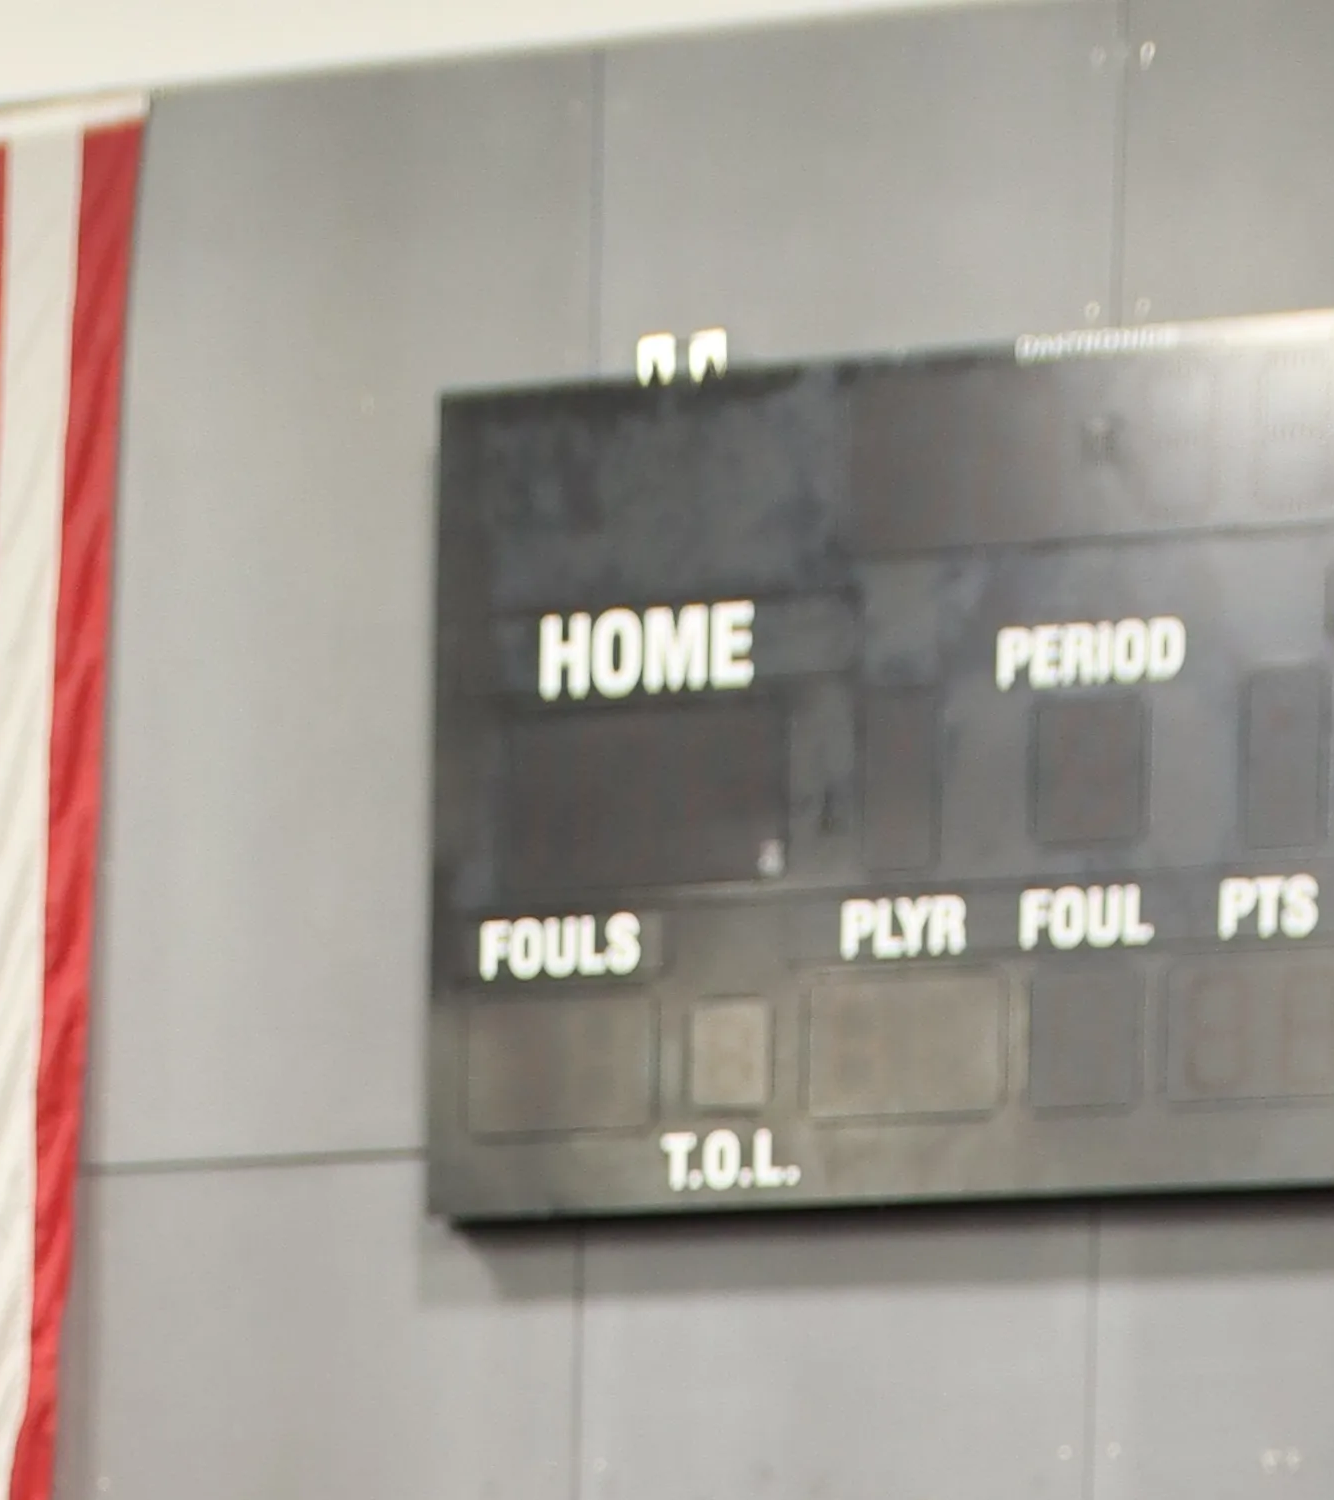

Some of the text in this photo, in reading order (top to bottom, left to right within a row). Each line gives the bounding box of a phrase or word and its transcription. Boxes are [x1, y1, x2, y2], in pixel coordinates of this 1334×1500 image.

[540, 601, 754, 697] HOME
[996, 616, 1186, 689] PERIOD
[841, 895, 966, 959] PLYR
[1020, 884, 1154, 949] FOUL
[1218, 874, 1318, 939] PTS
[480, 913, 640, 979] FOULS
[660, 1128, 801, 1191] T.O.L.
